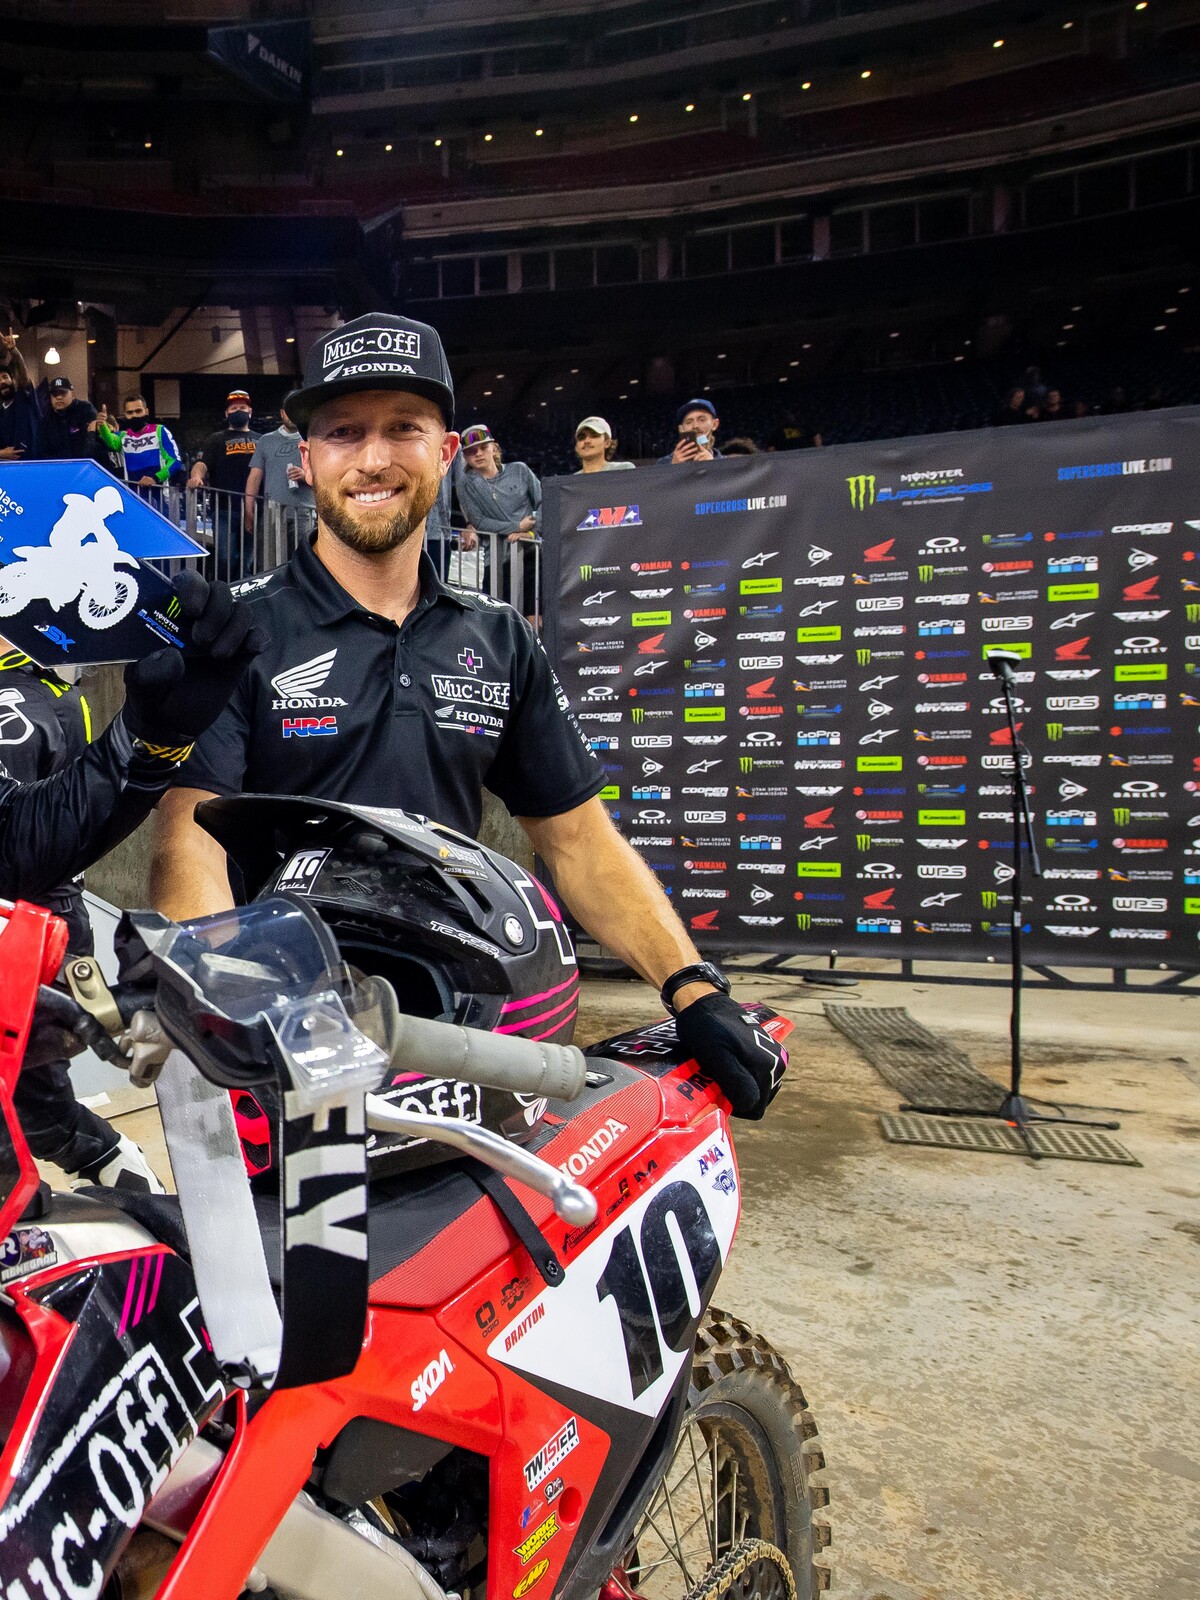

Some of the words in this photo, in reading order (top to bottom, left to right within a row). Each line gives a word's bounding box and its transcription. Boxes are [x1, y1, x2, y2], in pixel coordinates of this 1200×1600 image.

[327, 332, 418, 363] Muc-Off
[343, 363, 416, 375] HONDA
[901, 469, 964, 482] MONSTER
[876, 482, 993, 502] SUPERCROSS
[695, 495, 787, 515] SUPERCROSSLIVE.COM
[577, 505, 642, 527] AMA
[918, 546, 966, 555] OAKLEY
[640, 561, 672, 571] YAMAHA
[1048, 556, 1098, 566] GoPro
[744, 582, 778, 590] Kawasaki
[794, 576, 845, 586] COOPER
[856, 597, 904, 612] WPS
[694, 608, 726, 618] YAMAHA
[918, 619, 965, 628] GoPro
[982, 616, 1033, 631] WPS
[737, 631, 786, 641] COOPER
[1114, 647, 1168, 655] OAKLEY
[739, 656, 783, 670] WPS
[437, 678, 510, 708] Muc-Off
[684, 682, 725, 692] GoPro
[271, 697, 348, 710] HONDA
[1046, 696, 1099, 710] WPS
[1114, 694, 1166, 703] GoPro
[750, 705, 784, 715] YAMAHA
[455, 710, 504, 727] HONDA
[579, 712, 622, 722] COOPER
[282, 716, 338, 738] HRC
[797, 730, 840, 739] GoPro
[632, 735, 672, 747] WPS
[632, 785, 671, 793] GoPro
[681, 787, 729, 796] COOPER
[684, 811, 726, 823] WPS
[1046, 810, 1096, 819] GoPro
[740, 835, 781, 843] GoPro
[694, 861, 727, 870] YAMAHA
[737, 864, 786, 873] COOPER
[917, 865, 966, 879] WPS
[1112, 897, 1167, 912] WPS
[856, 917, 902, 926] GoPro
[698, 1146, 725, 1176] AMA
[285, 1091, 367, 1260] FLY
[596, 1180, 723, 1401] 10
[505, 1303, 545, 1353] BRAYTON
[412, 1348, 453, 1411] SKDA
[525, 1418, 576, 1482] TWISTED
[516, 1513, 556, 1556] WORKS
[513, 1559, 549, 1599] FMF
